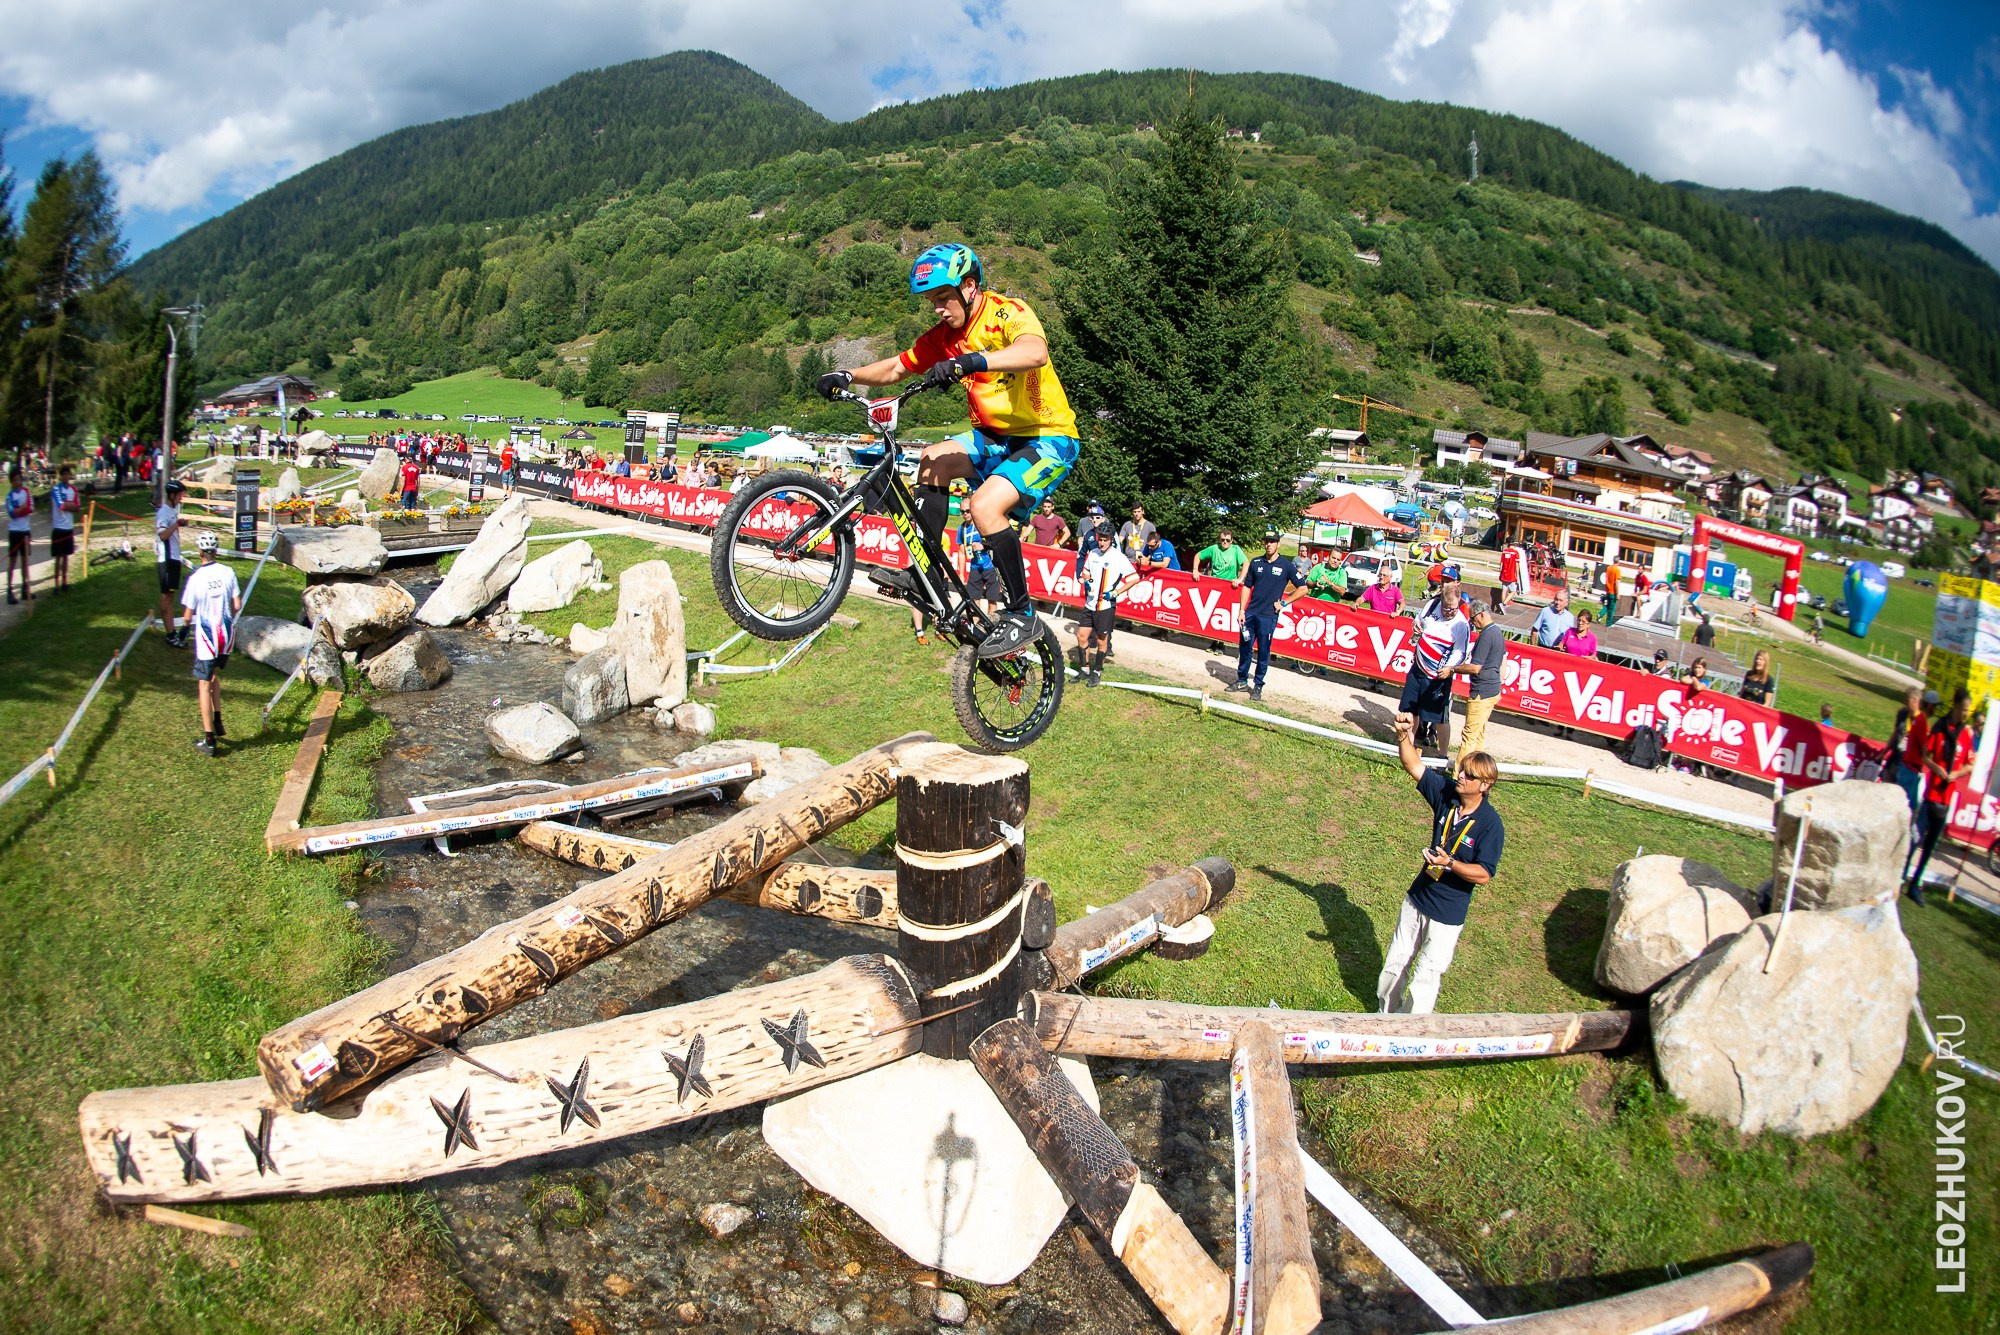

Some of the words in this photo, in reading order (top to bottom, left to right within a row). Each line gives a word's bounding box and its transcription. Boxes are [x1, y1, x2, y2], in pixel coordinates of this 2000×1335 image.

[244, 495, 251, 511] 1
[667, 491, 686, 517] Val
[695, 493, 726, 517] Sole
[893, 512, 931, 574] JITSIE
[208, 580, 222, 590] 320
[1037, 558, 1081, 597] Val
[1188, 588, 1241, 632] Val
[1367, 626, 1415, 673] Va
[1563, 671, 1625, 724] Val
[1625, 704, 1655, 729] di
[1657, 690, 1746, 746] Sole
[1752, 722, 1807, 775] Val
[1806, 756, 1833, 780] di
[1833, 742, 1882, 783] So
[1340, 1038, 1352, 1051] Val
[1360, 1040, 1381, 1053] Sole
[1388, 1042, 1427, 1055] TRENTINO
[1451, 1043, 1470, 1053] Sole
[1476, 1043, 1508, 1054] TRENTINO
